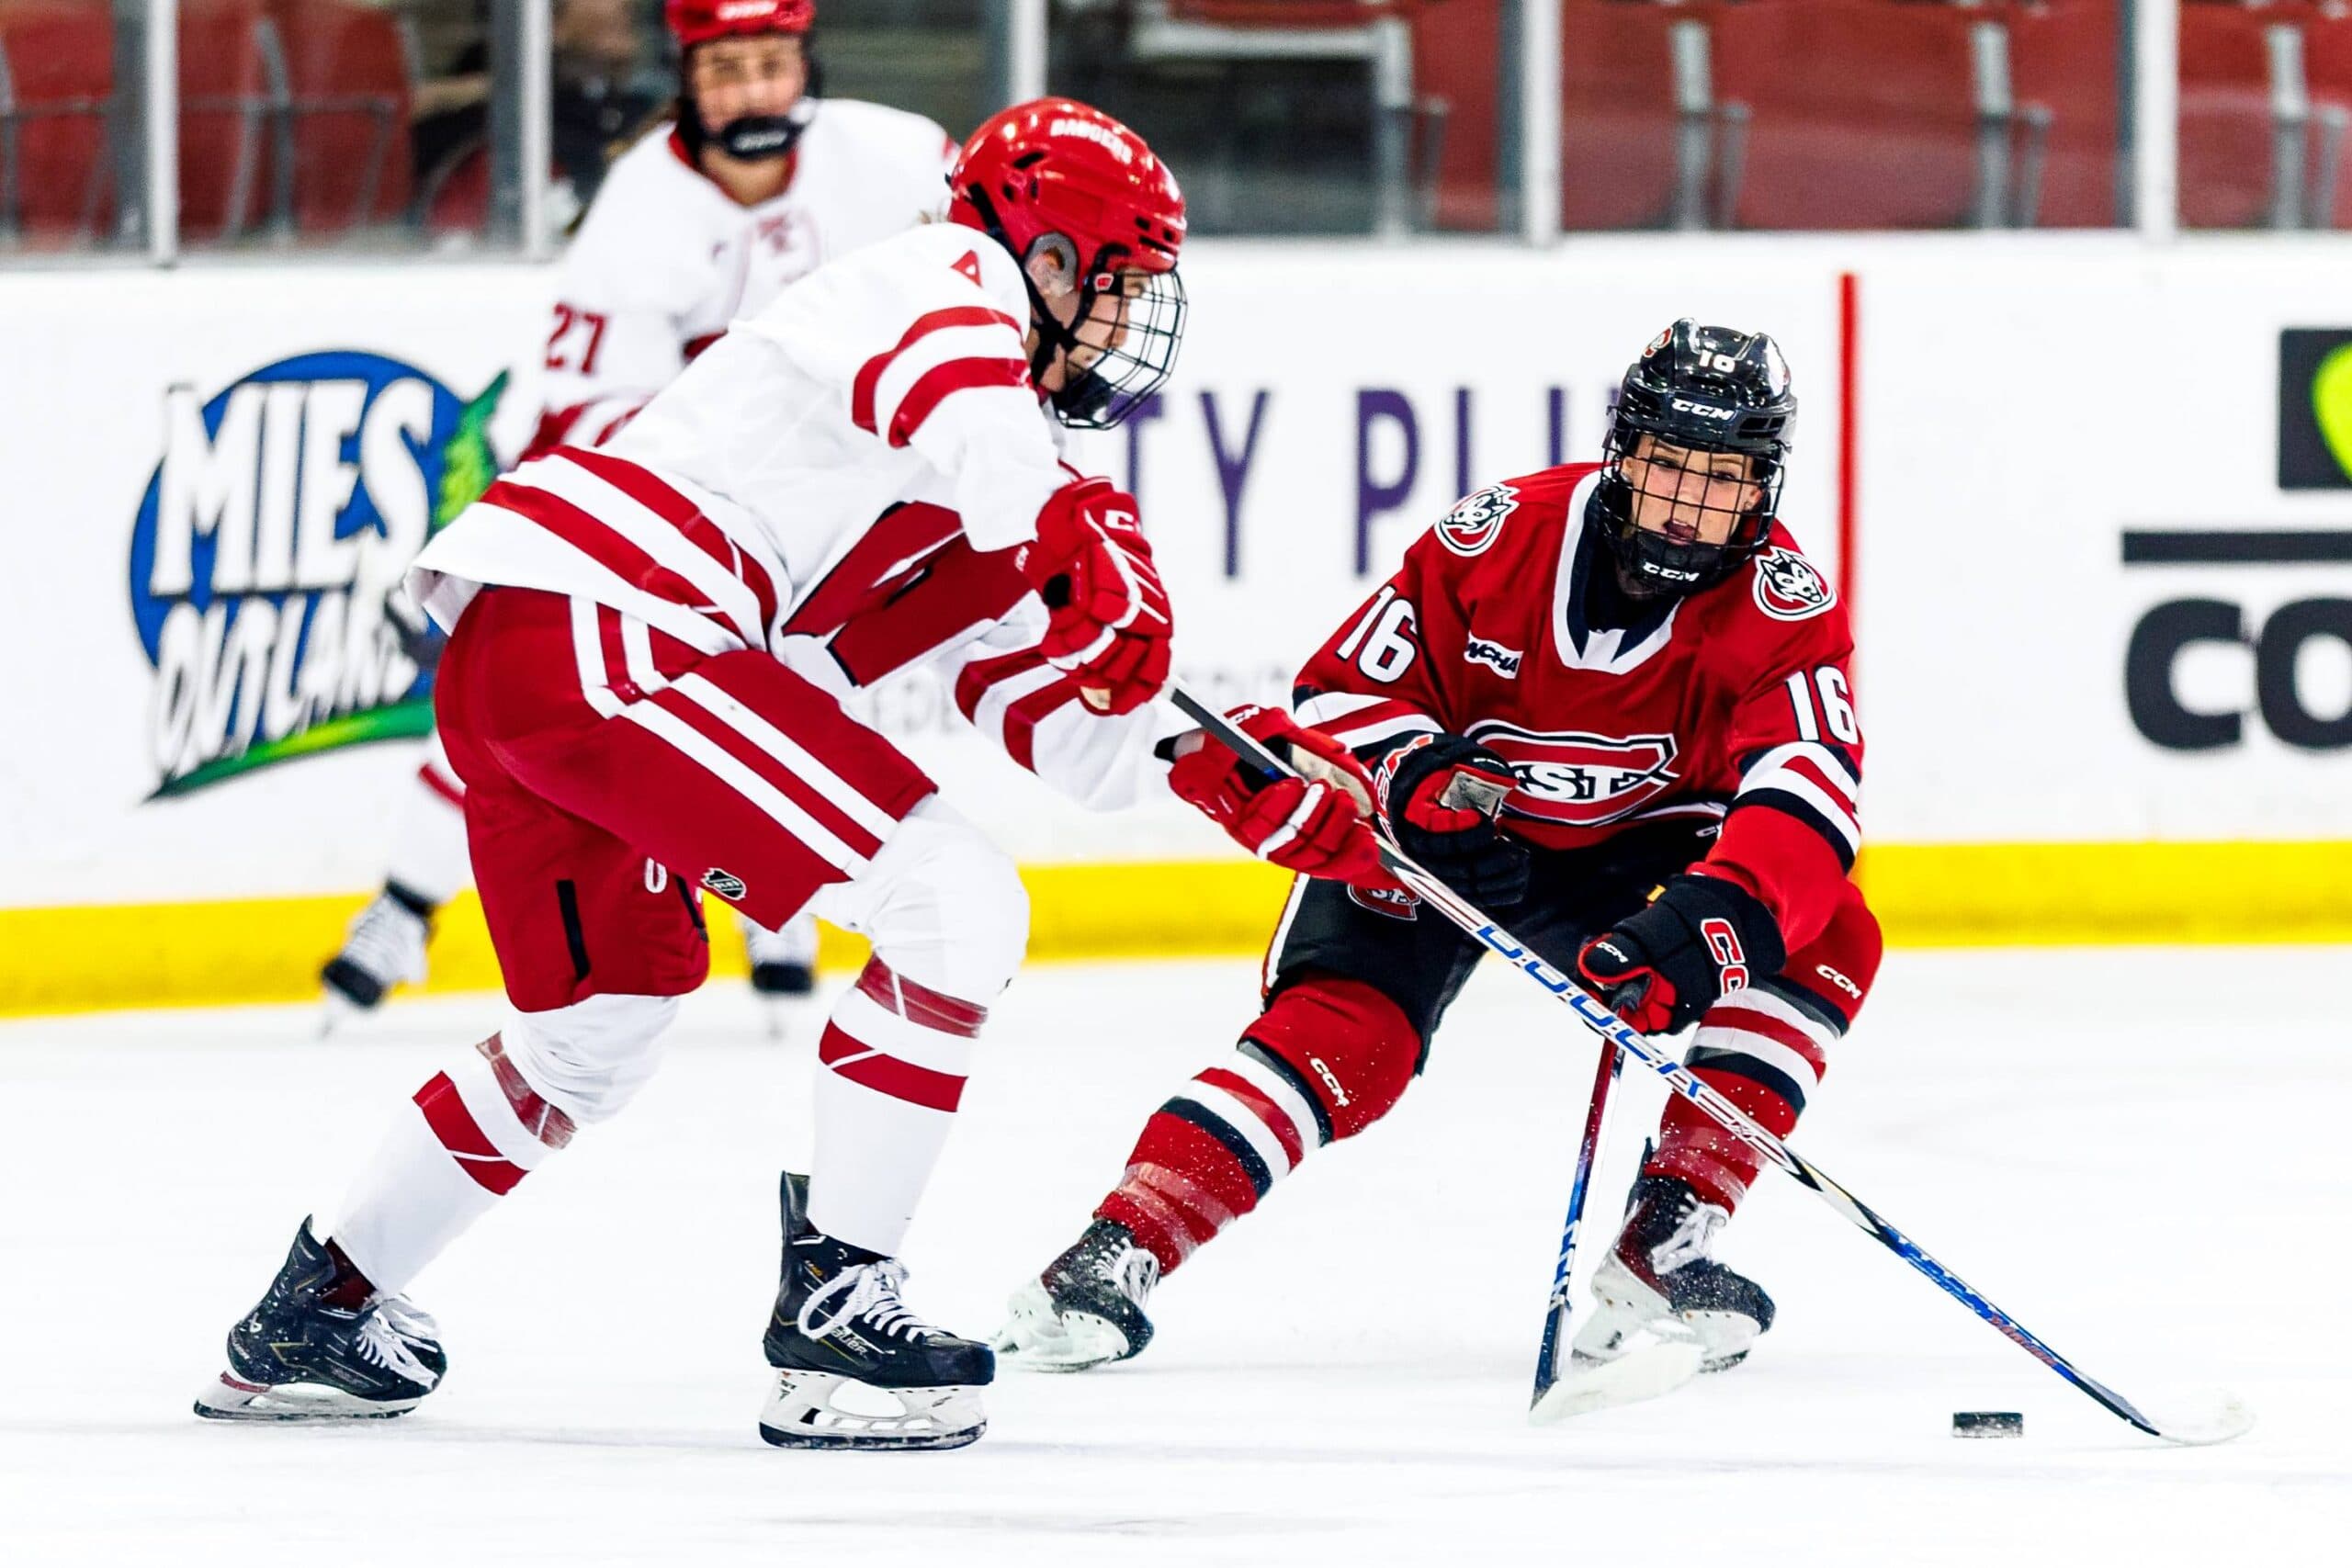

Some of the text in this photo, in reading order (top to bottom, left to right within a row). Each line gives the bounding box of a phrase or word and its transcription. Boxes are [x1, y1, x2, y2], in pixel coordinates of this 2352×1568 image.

[545, 302, 605, 374] 27
[1699, 349, 1736, 373] 16
[1672, 398, 1735, 421] CCM
[151, 378, 435, 594] MIES
[1643, 561, 1700, 581] CCM
[1337, 584, 1417, 682] 16
[1785, 665, 1860, 745] 16
[1596, 941, 1629, 964] CCM
[1815, 964, 1863, 1000] CCM
[1310, 1057, 1351, 1108] CCM
